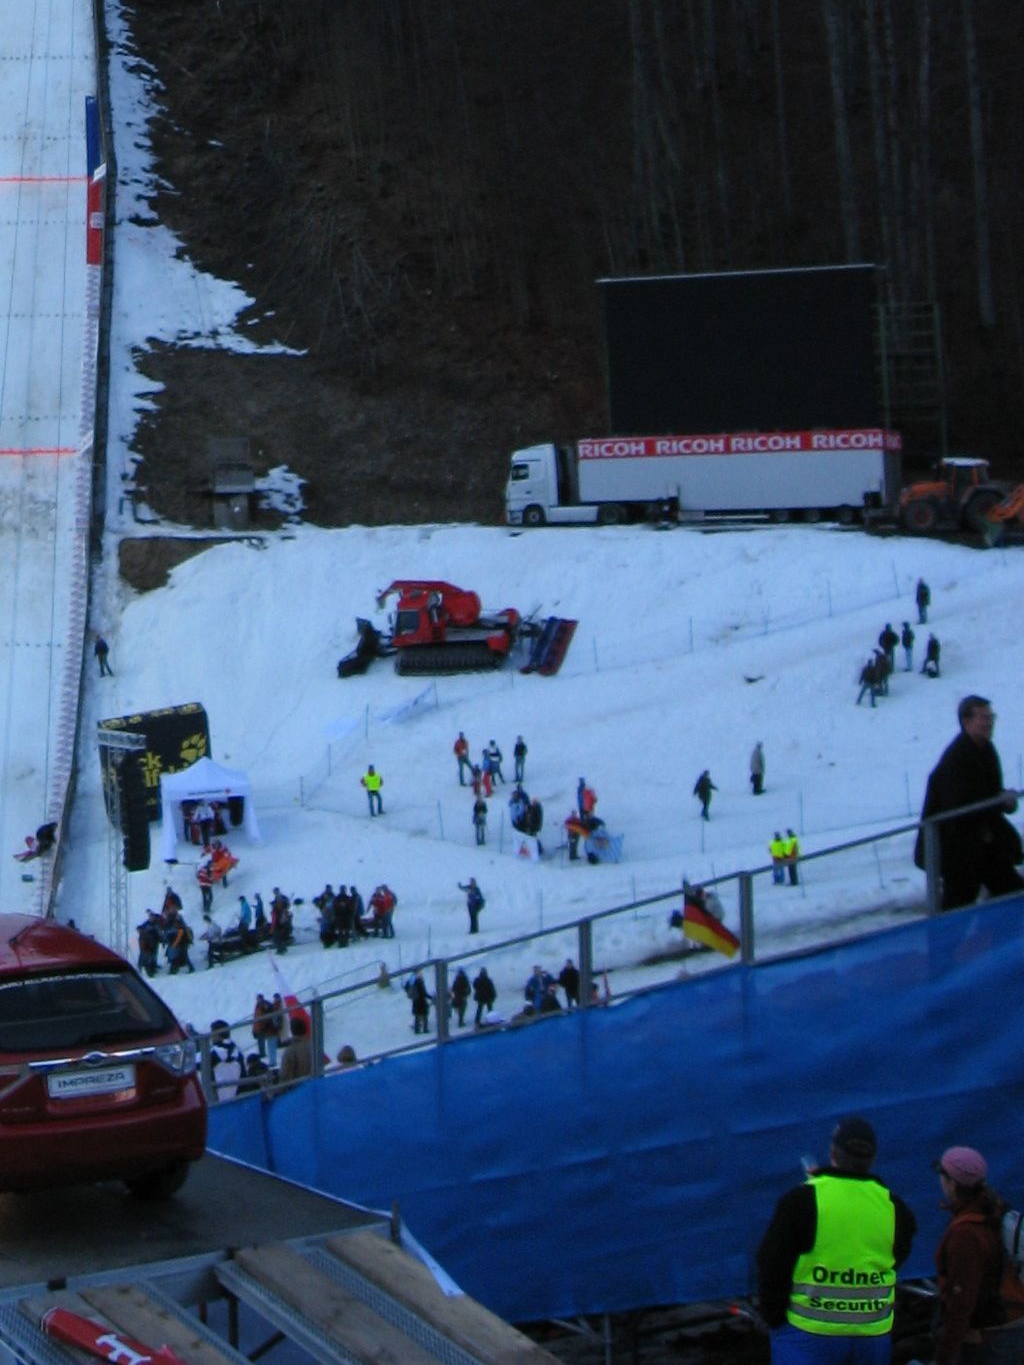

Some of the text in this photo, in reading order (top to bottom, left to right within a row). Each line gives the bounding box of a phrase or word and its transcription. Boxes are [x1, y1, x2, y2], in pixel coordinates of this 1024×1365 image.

[578, 442, 646, 458] RICOH
[656, 438, 725, 454] RICOH
[731, 435, 801, 451] RICOH
[812, 432, 884, 449] RICOH
[57, 1071, 125, 1090] IMPREZA
[812, 1265, 888, 1285] Ordner
